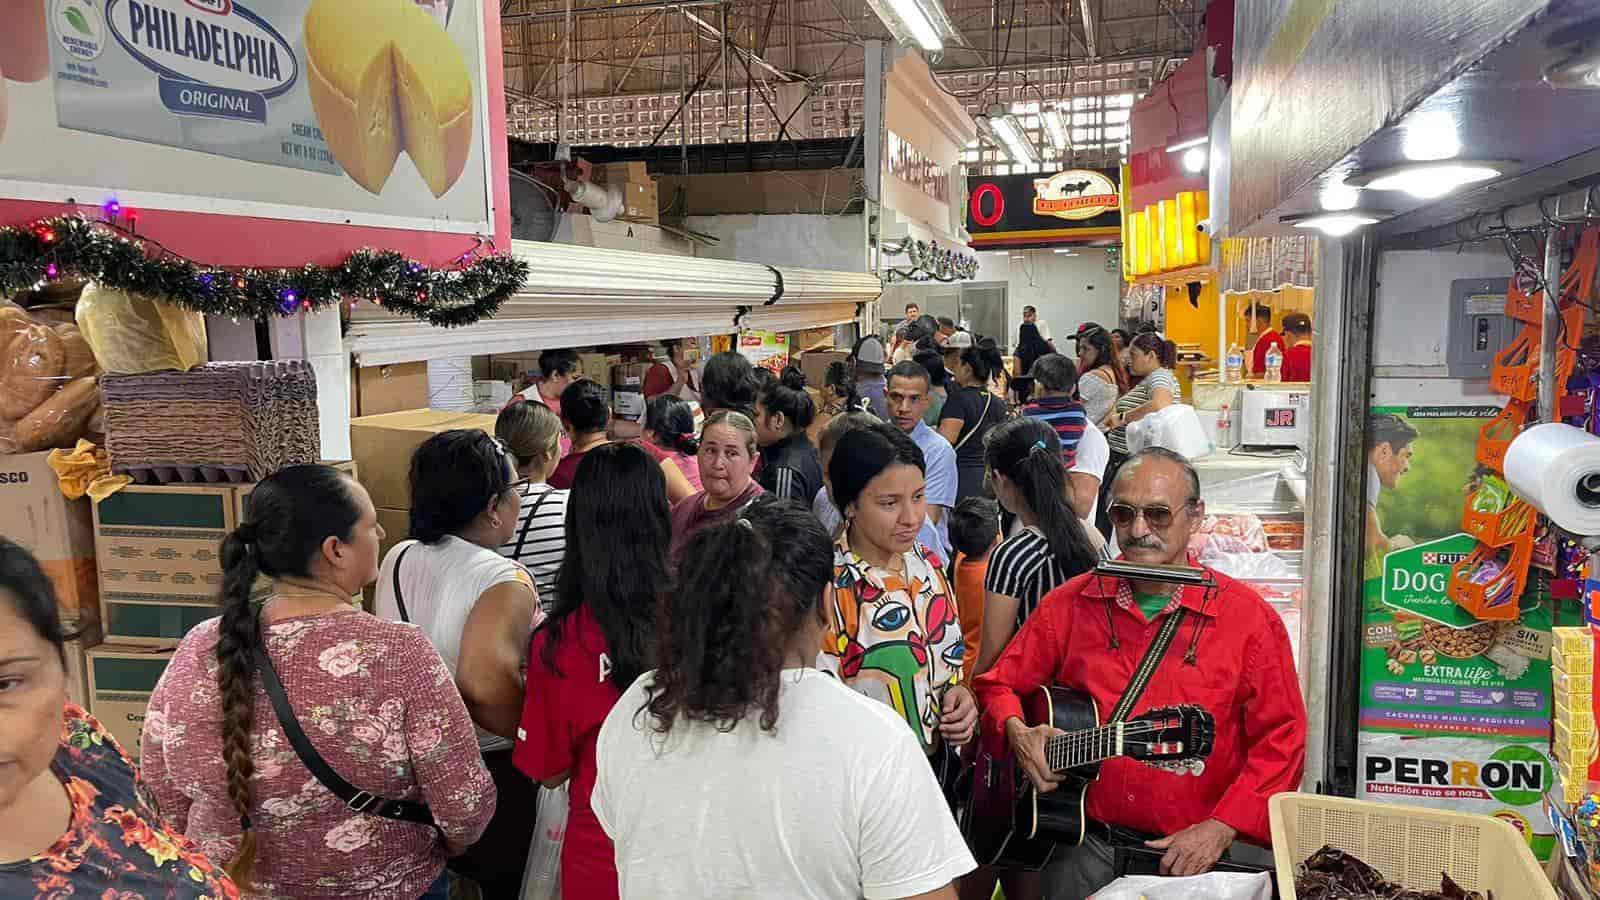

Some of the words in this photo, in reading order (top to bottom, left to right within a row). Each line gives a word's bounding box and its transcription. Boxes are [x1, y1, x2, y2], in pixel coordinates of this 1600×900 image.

[129, 0, 282, 81] PHILADELPHIA
[180, 89, 253, 113] ORIGINAL
[1266, 409, 1294, 427] JR
[1391, 567, 1446, 593] DOG
[1517, 630, 1540, 642] SIN
[1423, 664, 1463, 678] EXTRA
[1366, 756, 1542, 790] PERRON
[1370, 783, 1420, 795] Nutrición
[1422, 788, 1442, 797] que
[1458, 790, 1484, 798] nota
